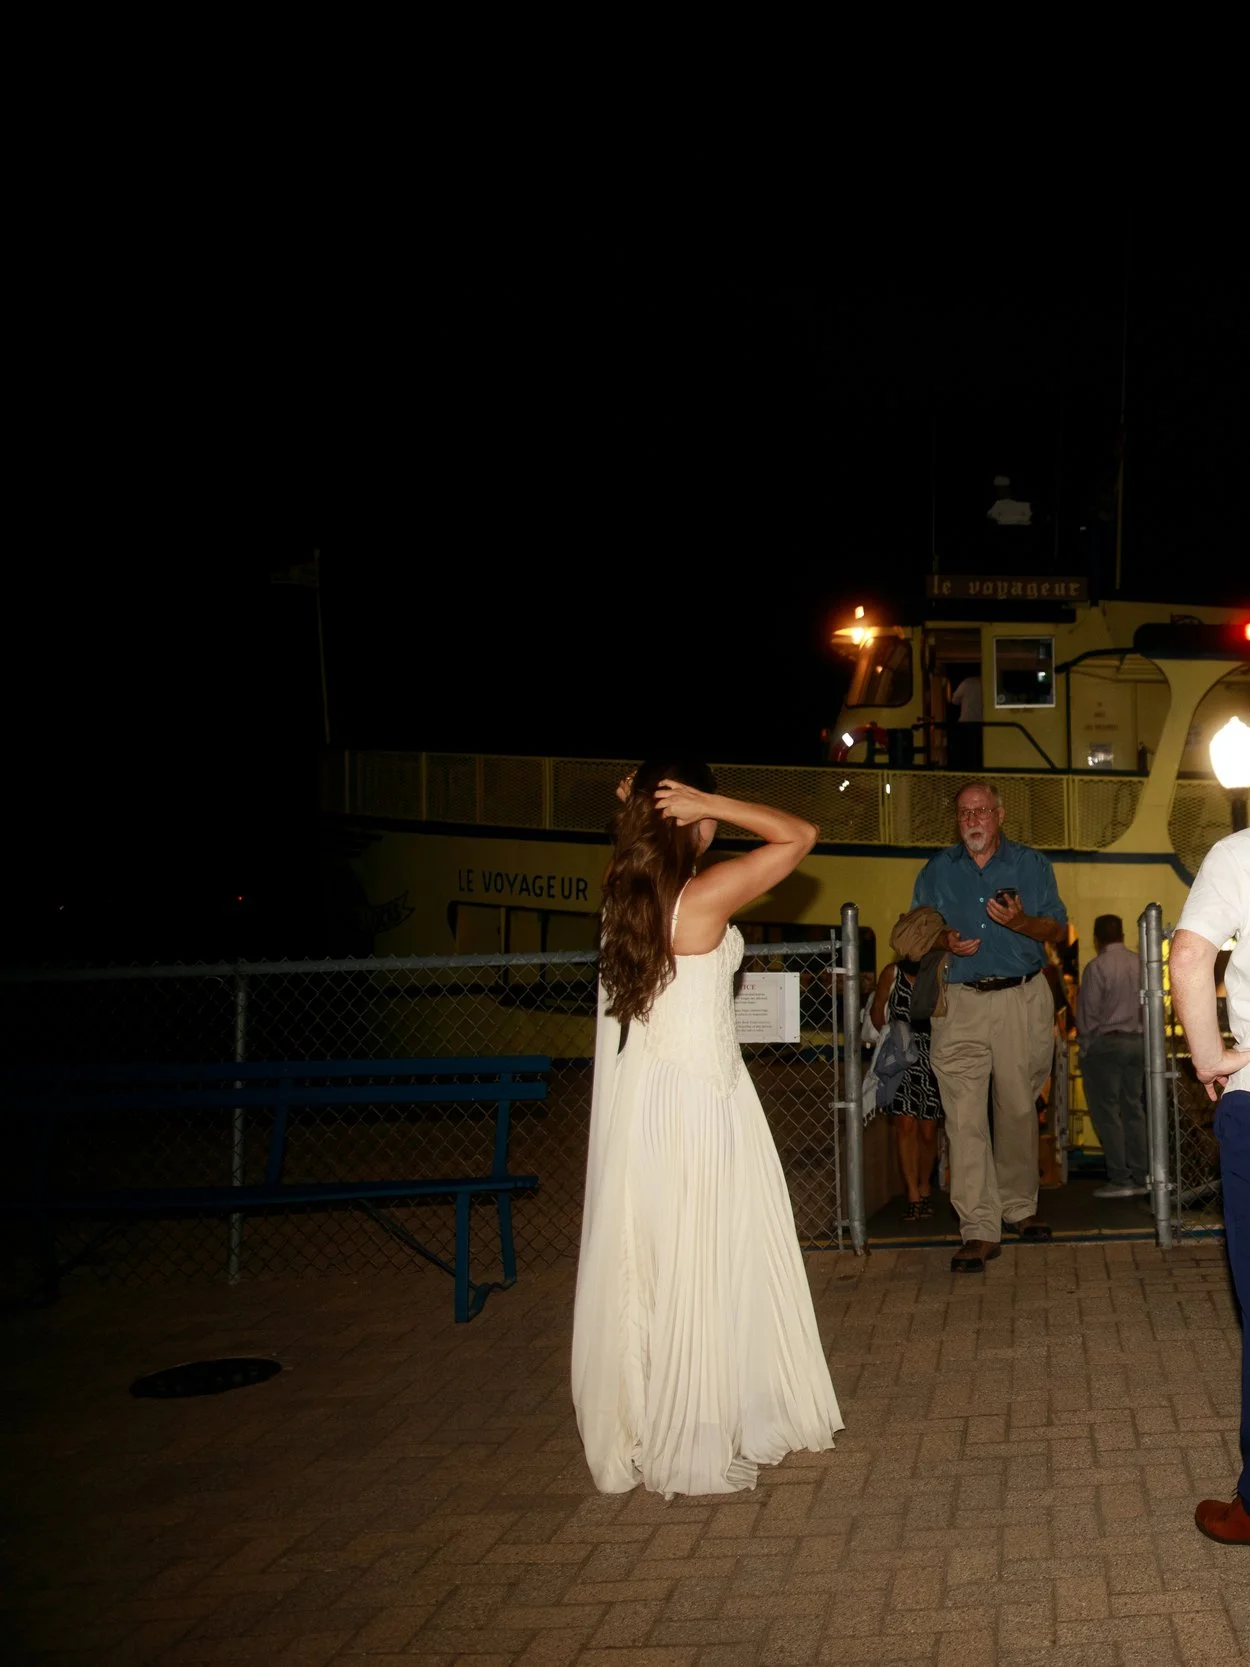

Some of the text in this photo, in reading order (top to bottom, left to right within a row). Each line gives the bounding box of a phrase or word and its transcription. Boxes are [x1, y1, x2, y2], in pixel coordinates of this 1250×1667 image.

[932, 575, 1081, 600] le voyageur
[458, 869, 588, 902] LE VOYAGEUR
